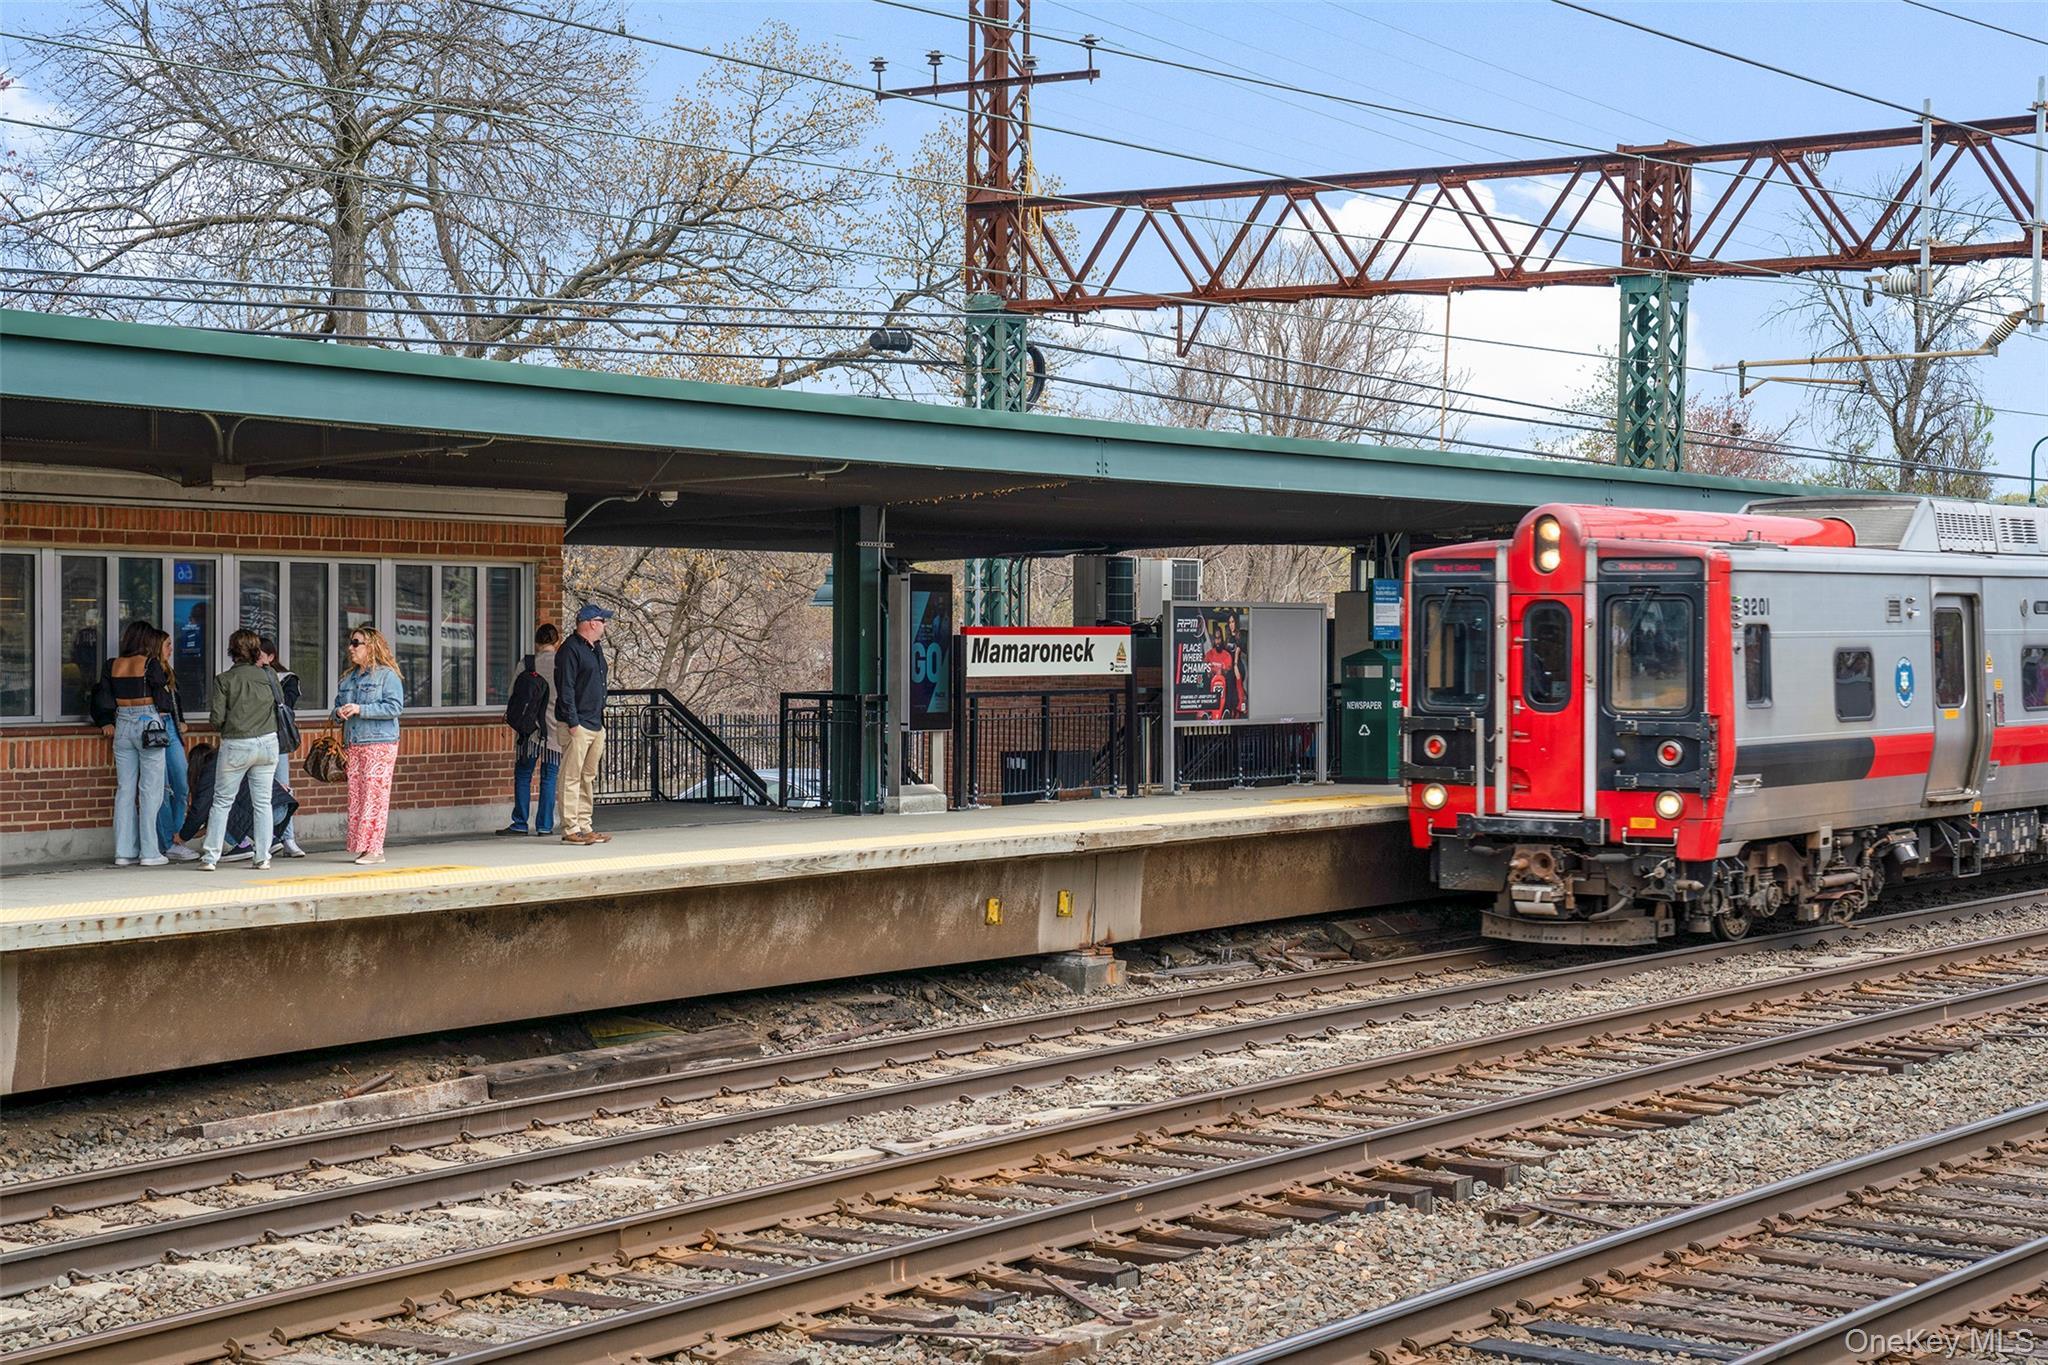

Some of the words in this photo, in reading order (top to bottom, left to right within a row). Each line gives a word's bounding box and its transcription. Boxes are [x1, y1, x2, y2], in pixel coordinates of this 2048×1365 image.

[1743, 598, 1771, 616] 9201
[1176, 618, 1199, 628] RPM
[971, 637, 1095, 664] Mamaroneck
[1182, 643, 1202, 652] PLACE
[1182, 653, 1204, 662] WHERE
[911, 642, 942, 684] GO
[1182, 663, 1212, 673] CHAMPS
[1181, 674, 1198, 684] RACE
[1346, 701, 1383, 710] NEWSPAPER
